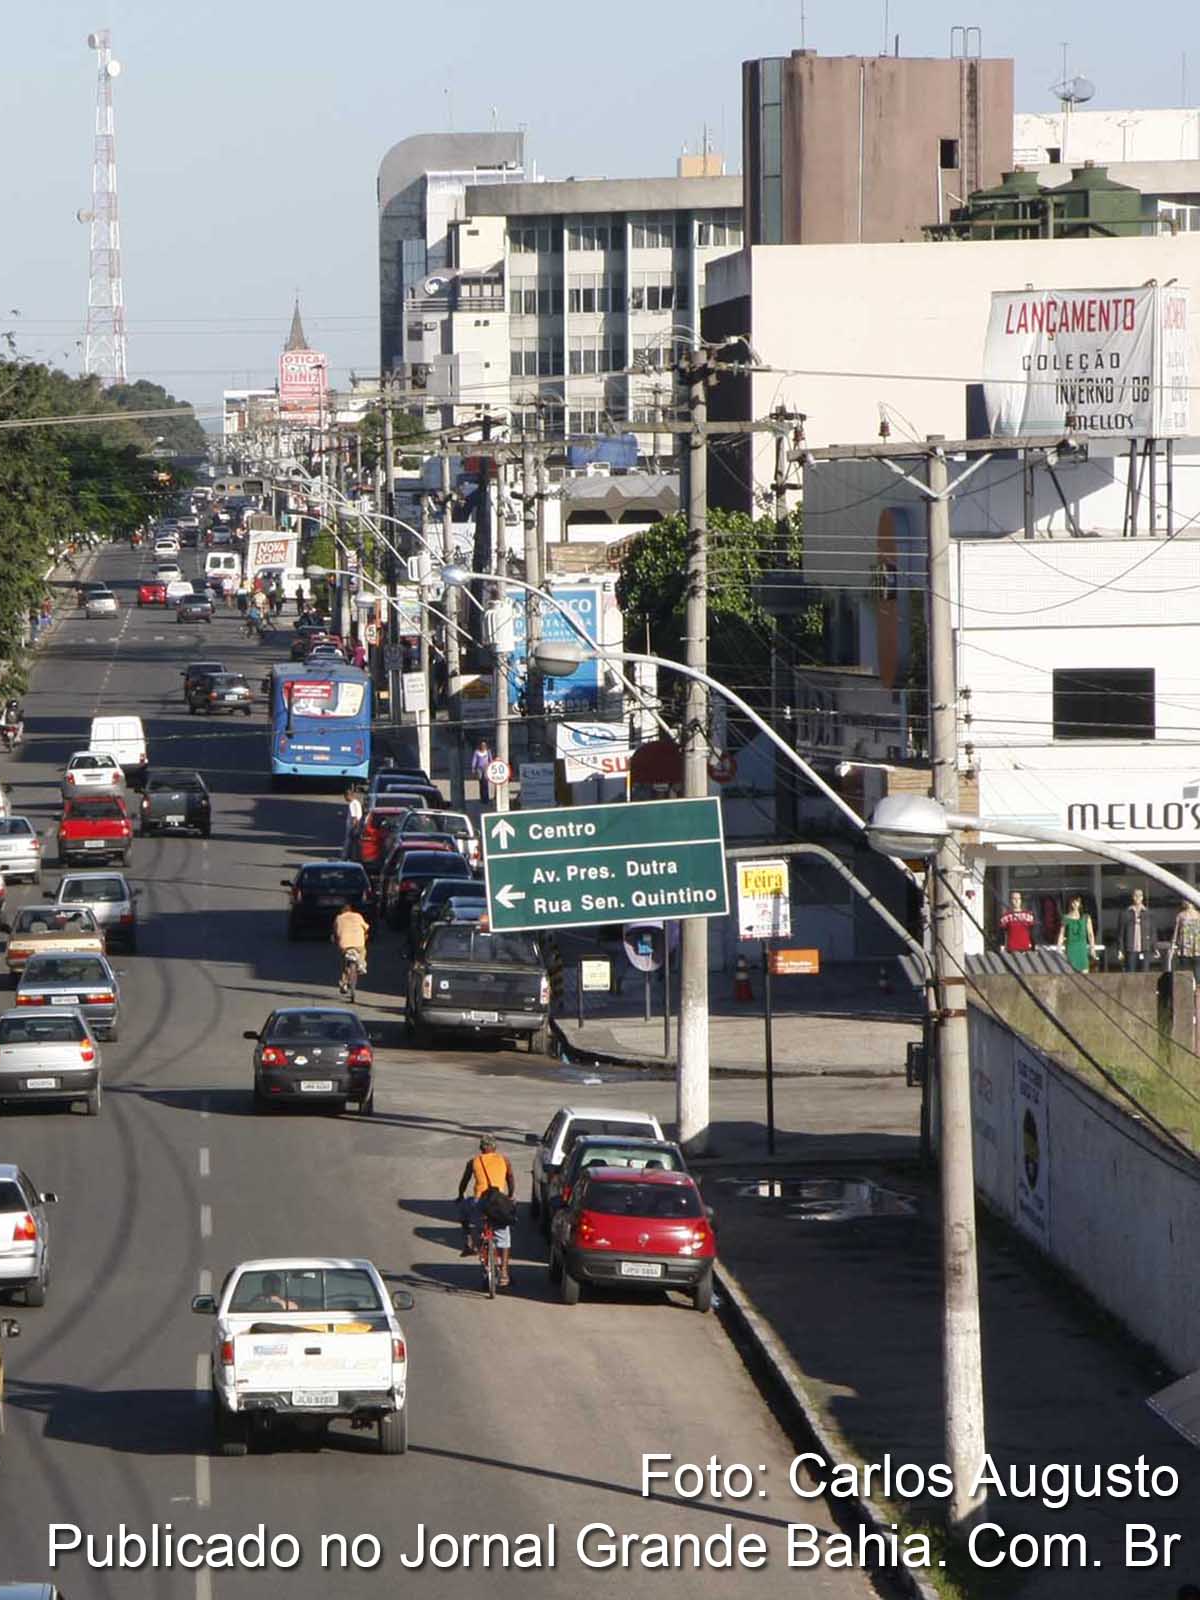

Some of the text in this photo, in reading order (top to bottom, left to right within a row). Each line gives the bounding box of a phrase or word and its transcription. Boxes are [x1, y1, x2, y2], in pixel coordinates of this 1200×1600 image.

[1005, 298, 1136, 340] LANÇAMENTO
[1022, 349, 1121, 373] COLEÇÃO
[1055, 377, 1115, 404] INVERNO
[258, 542, 286, 554] NOVA
[491, 764, 505, 775] 50
[528, 822, 596, 840] Centro
[532, 859, 678, 884] Av. Pres. Dutra
[744, 870, 783, 889] Feira
[534, 887, 717, 914] Rua Sen. Quintino
